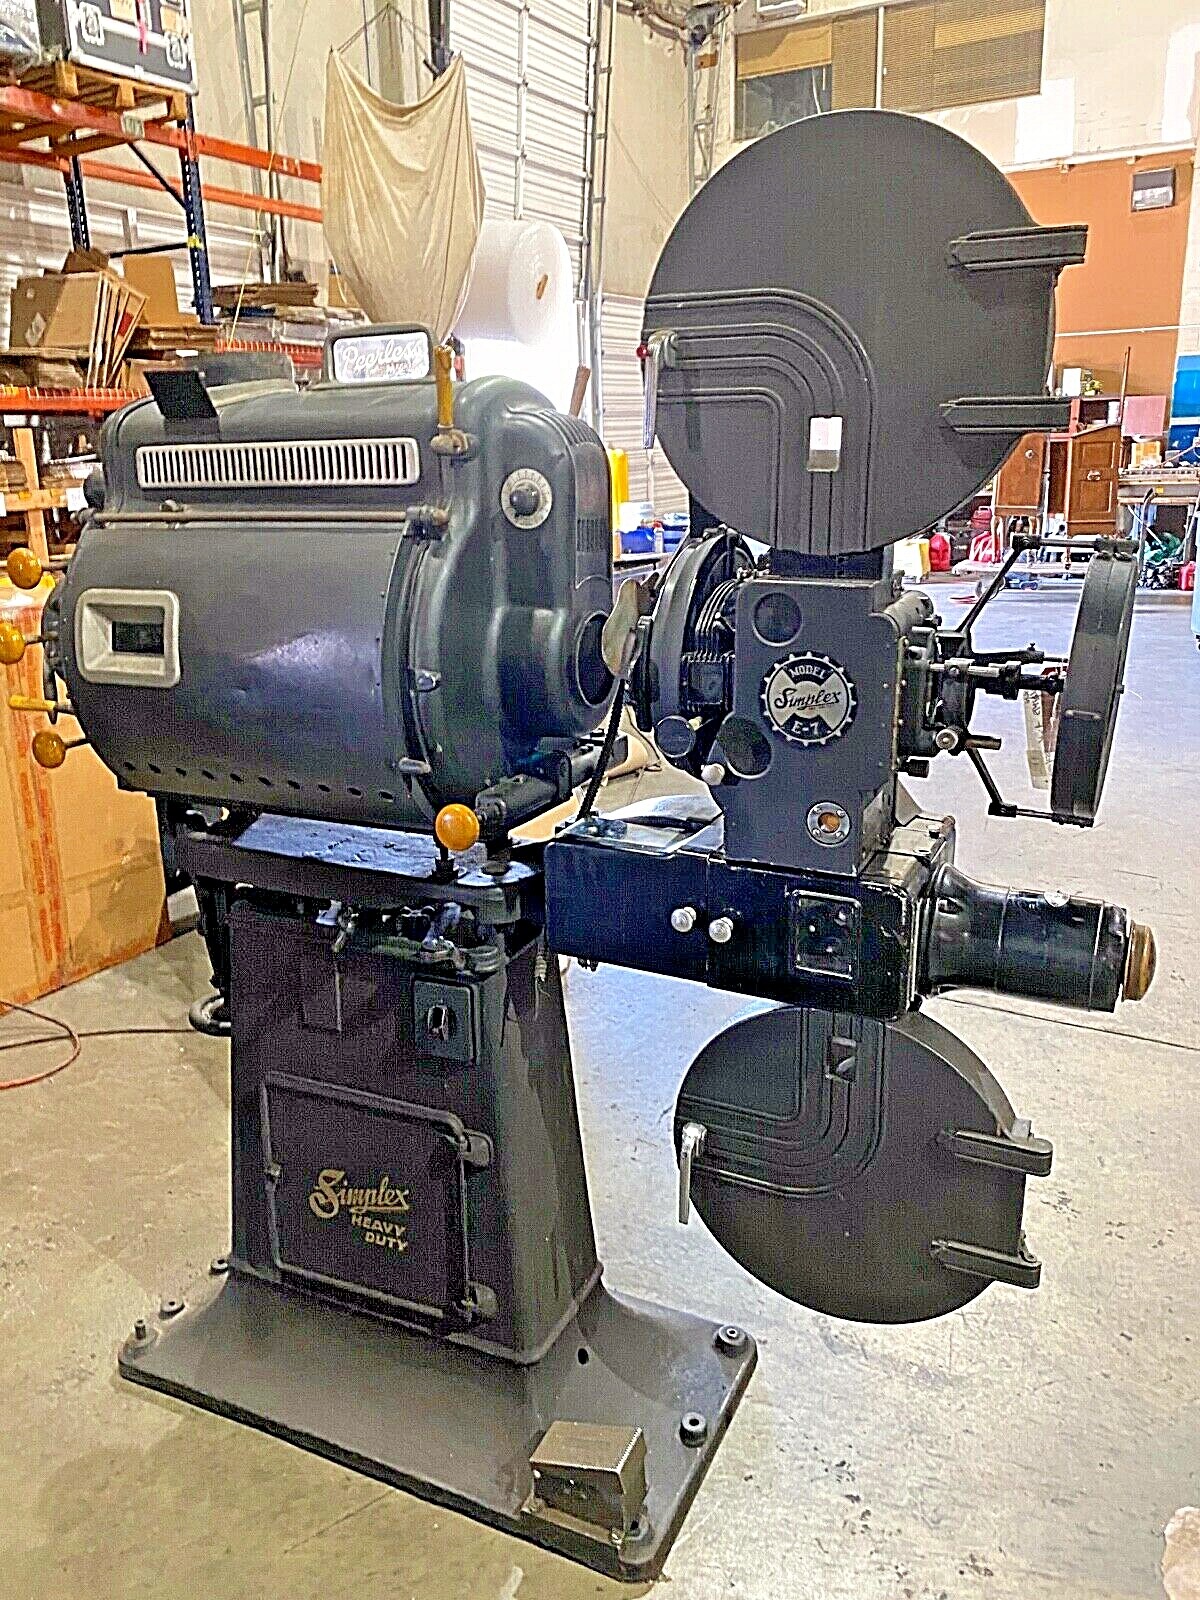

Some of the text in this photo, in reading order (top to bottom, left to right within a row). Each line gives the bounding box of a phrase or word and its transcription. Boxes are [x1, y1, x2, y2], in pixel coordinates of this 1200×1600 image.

[342, 338, 423, 376] Peerless
[789, 665, 827, 679] MODEL
[774, 688, 841, 710] Simplex
[791, 721, 819, 735] E-7
[309, 1169, 409, 1218] Simplex
[351, 1214, 406, 1237] HEAVY
[365, 1231, 408, 1251] DUTY
